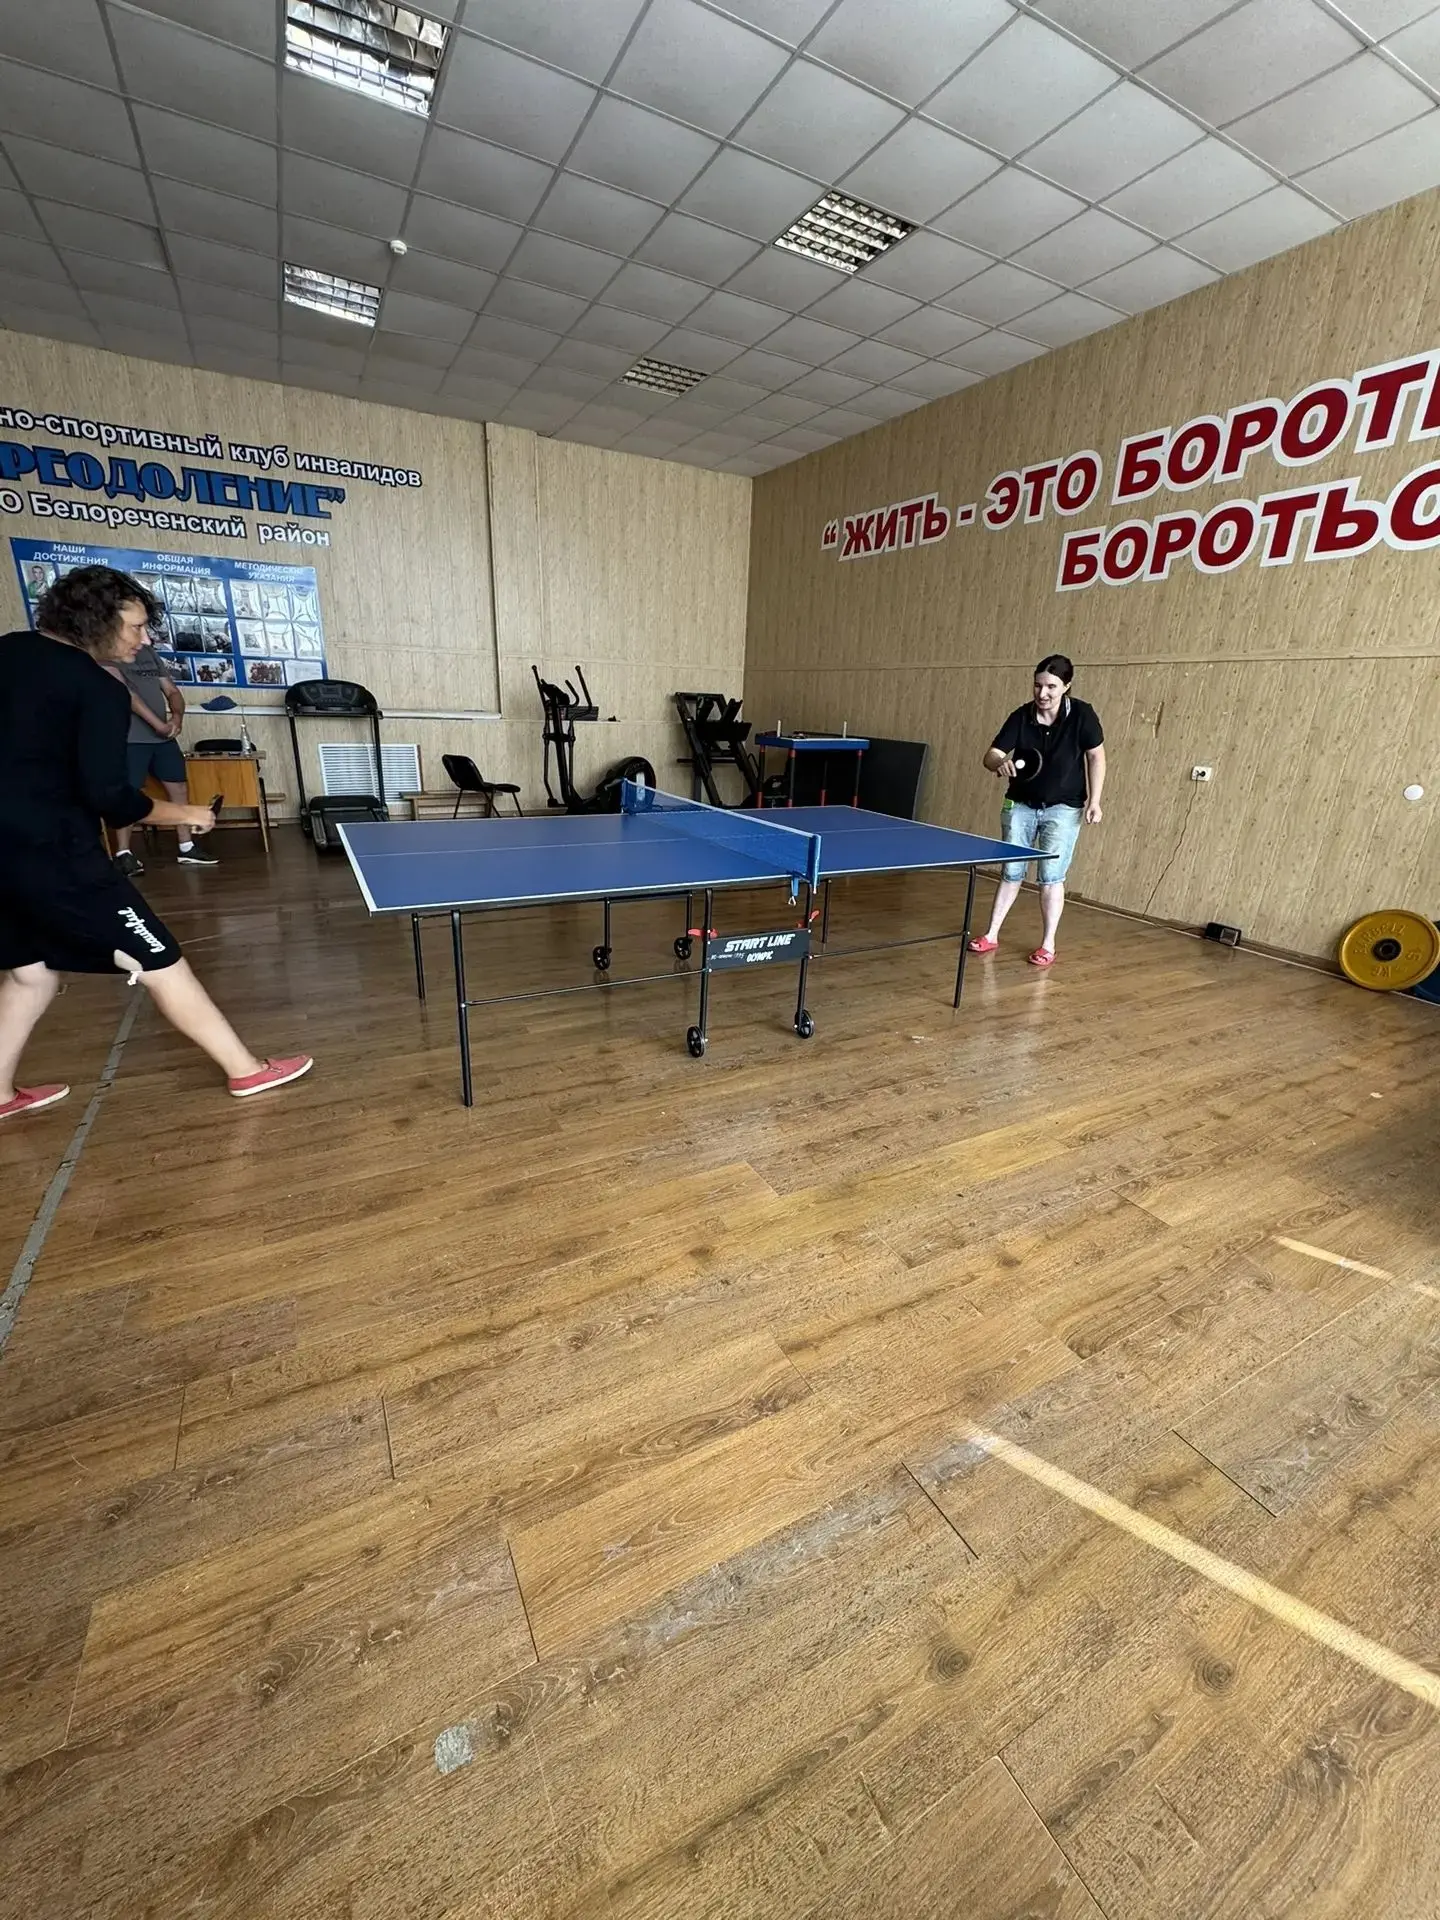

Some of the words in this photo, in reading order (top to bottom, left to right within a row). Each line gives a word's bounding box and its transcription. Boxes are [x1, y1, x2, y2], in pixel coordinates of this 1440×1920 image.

[228, 443, 290, 470] клуб
[295, 452, 423, 487] инвалидов
[984, 453, 1099, 528] ЭТО
[28, 491, 247, 538] Белореченский
[257, 522, 331, 546] район
[53, 543, 86, 554] НАШИ
[33, 551, 109, 566] ДОСТИЖЕНИЯ
[157, 553, 194, 565] ОБЩАЯ
[142, 561, 211, 576] ИНФОРМАЦИЯ
[248, 571, 295, 583] УКАЗАНИЯ
[724, 937, 768, 953] START
[766, 933, 796, 948] LINE
[746, 950, 774, 963] OLYMPIC
